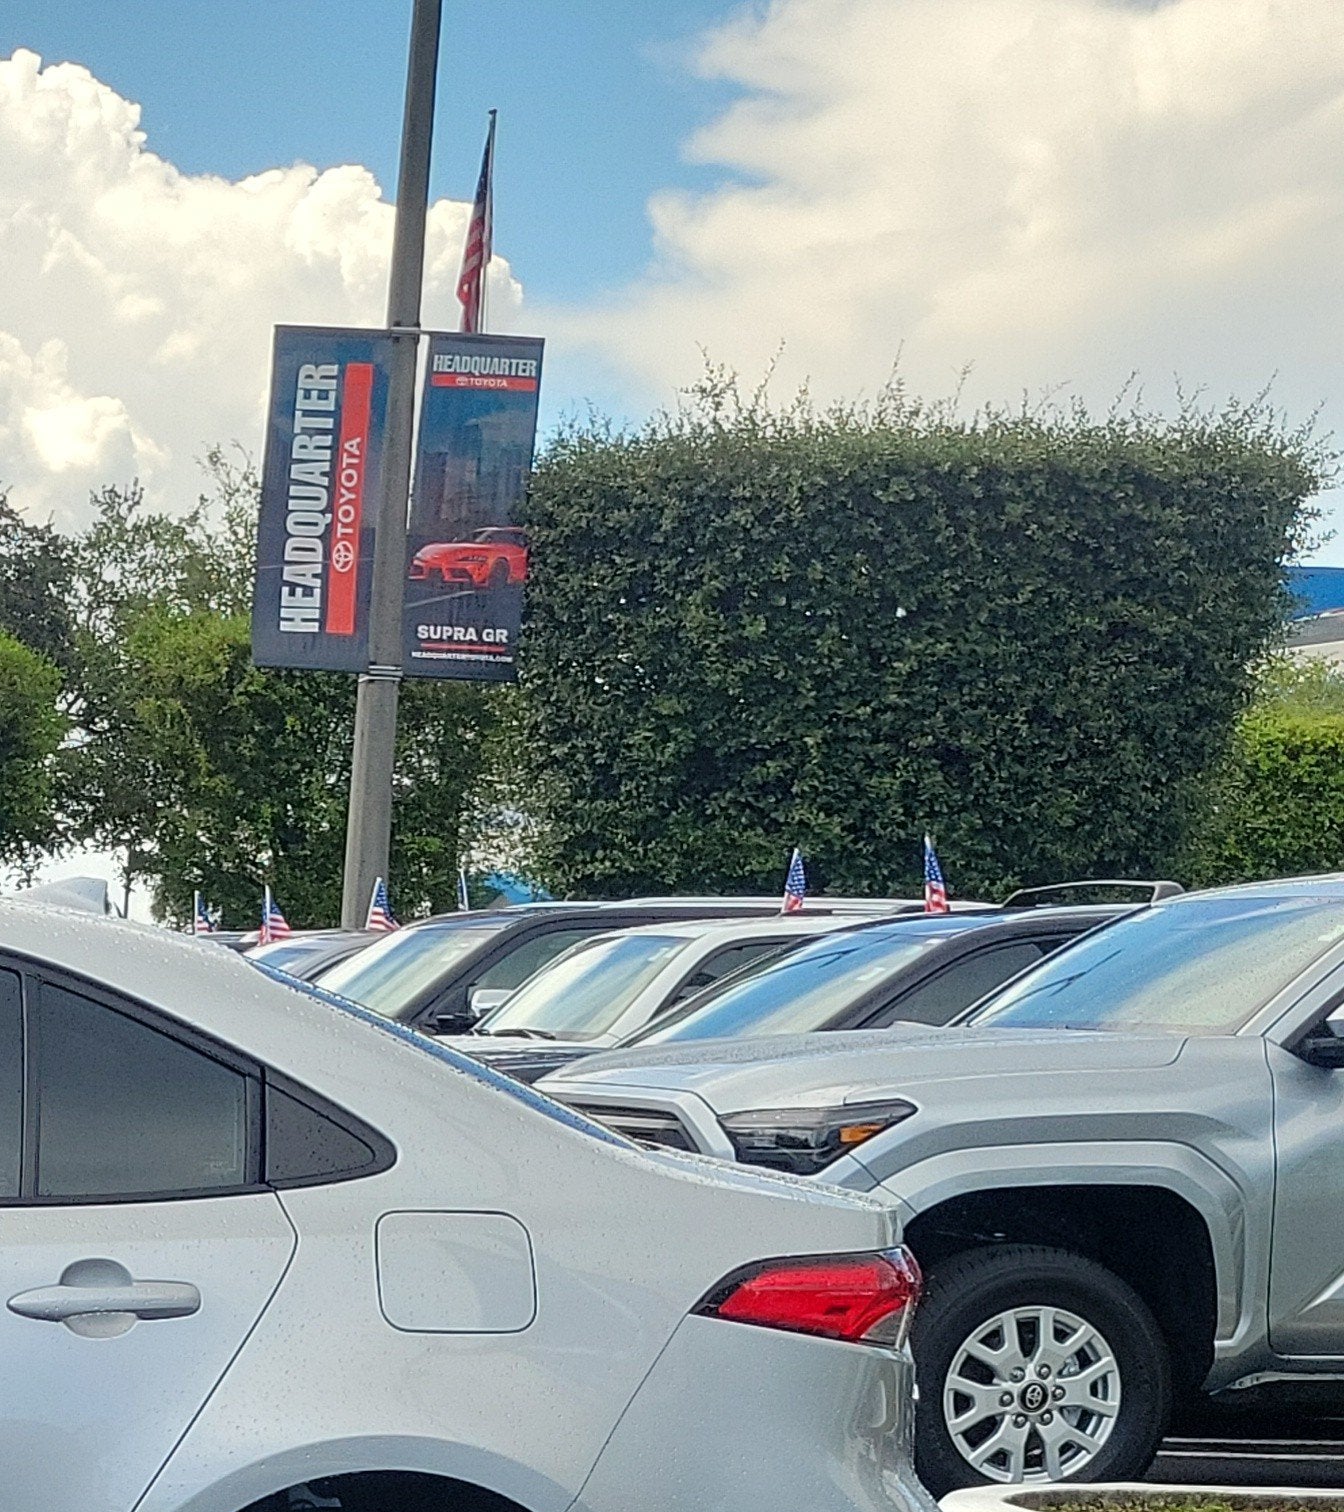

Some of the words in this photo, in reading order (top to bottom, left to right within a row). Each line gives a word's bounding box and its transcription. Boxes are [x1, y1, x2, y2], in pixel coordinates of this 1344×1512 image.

[433, 354, 537, 377] HEADQUARTER
[469, 377, 508, 387] TOYOTA
[279, 363, 339, 633] HEADQUARTER
[337, 437, 361, 538] TOYOTA
[417, 624, 478, 641] SUPRA
[482, 628, 509, 643] GR
